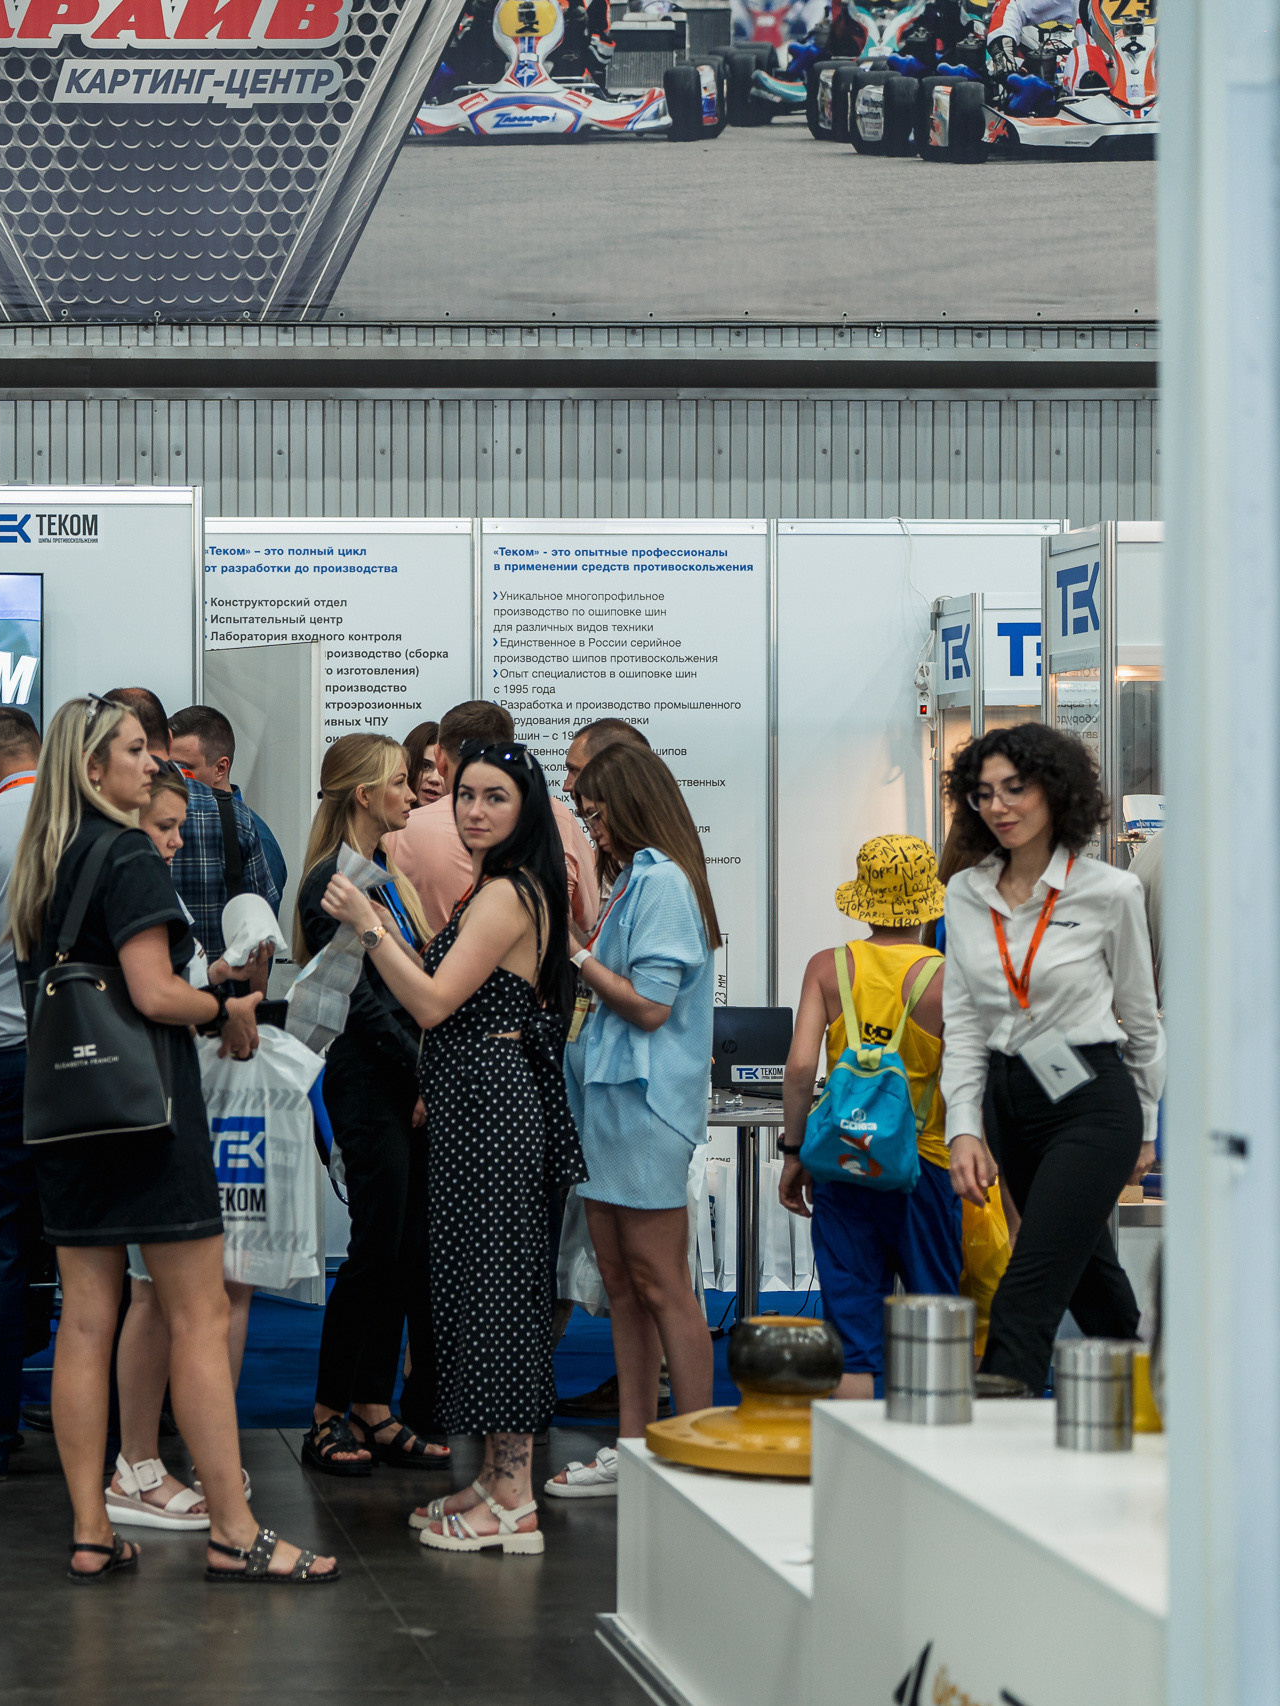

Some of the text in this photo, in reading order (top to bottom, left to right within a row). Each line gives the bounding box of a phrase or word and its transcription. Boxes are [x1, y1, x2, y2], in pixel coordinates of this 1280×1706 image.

[64, 68, 335, 98] КАРТИНГ-ЦЕНТР
[35, 514, 99, 536] ТЕКОМ
[263, 548, 285, 556] это
[287, 546, 334, 556] полный
[337, 548, 367, 558] цикл
[493, 546, 728, 559] «Теком» это опытные профессионалы
[204, 563, 398, 575] от разработки до производства
[504, 563, 578, 573] применении
[581, 563, 630, 573] средств
[633, 563, 754, 573] противоскольжения
[499, 590, 665, 603] Уникальное многопрофильное
[210, 597, 348, 610] Конструкторский отдел
[493, 608, 667, 618] производство по ошиповке шин
[210, 614, 344, 627] Испытательный центр
[492, 624, 654, 634] для различных видов техники
[209, 631, 402, 644] Лаборатория входного контроля
[500, 637, 576, 649] Единственное
[588, 637, 628, 648] России
[630, 637, 682, 650] серийное
[404, 648, 449, 661] (сборка
[493, 655, 718, 665] производство шипов противоскольжения
[336, 665, 420, 678] изготовления)
[499, 668, 529, 679] Опыт
[531, 670, 607, 680] специалистов
[618, 670, 673, 679] ошиповке
[675, 670, 697, 679] шин
[325, 684, 408, 695] производство
[503, 684, 529, 694] 1995
[531, 686, 556, 696] года
[325, 701, 423, 712] ктроэрозионных
[499, 699, 564, 712] Разработка
[575, 701, 651, 712] производство
[653, 701, 742, 712] промышленного
[364, 716, 389, 727] ЧПУ
[513, 716, 593, 728] рудования для
[513, 732, 540, 741] ошин
[218, 1187, 266, 1212] ЕКОМ
